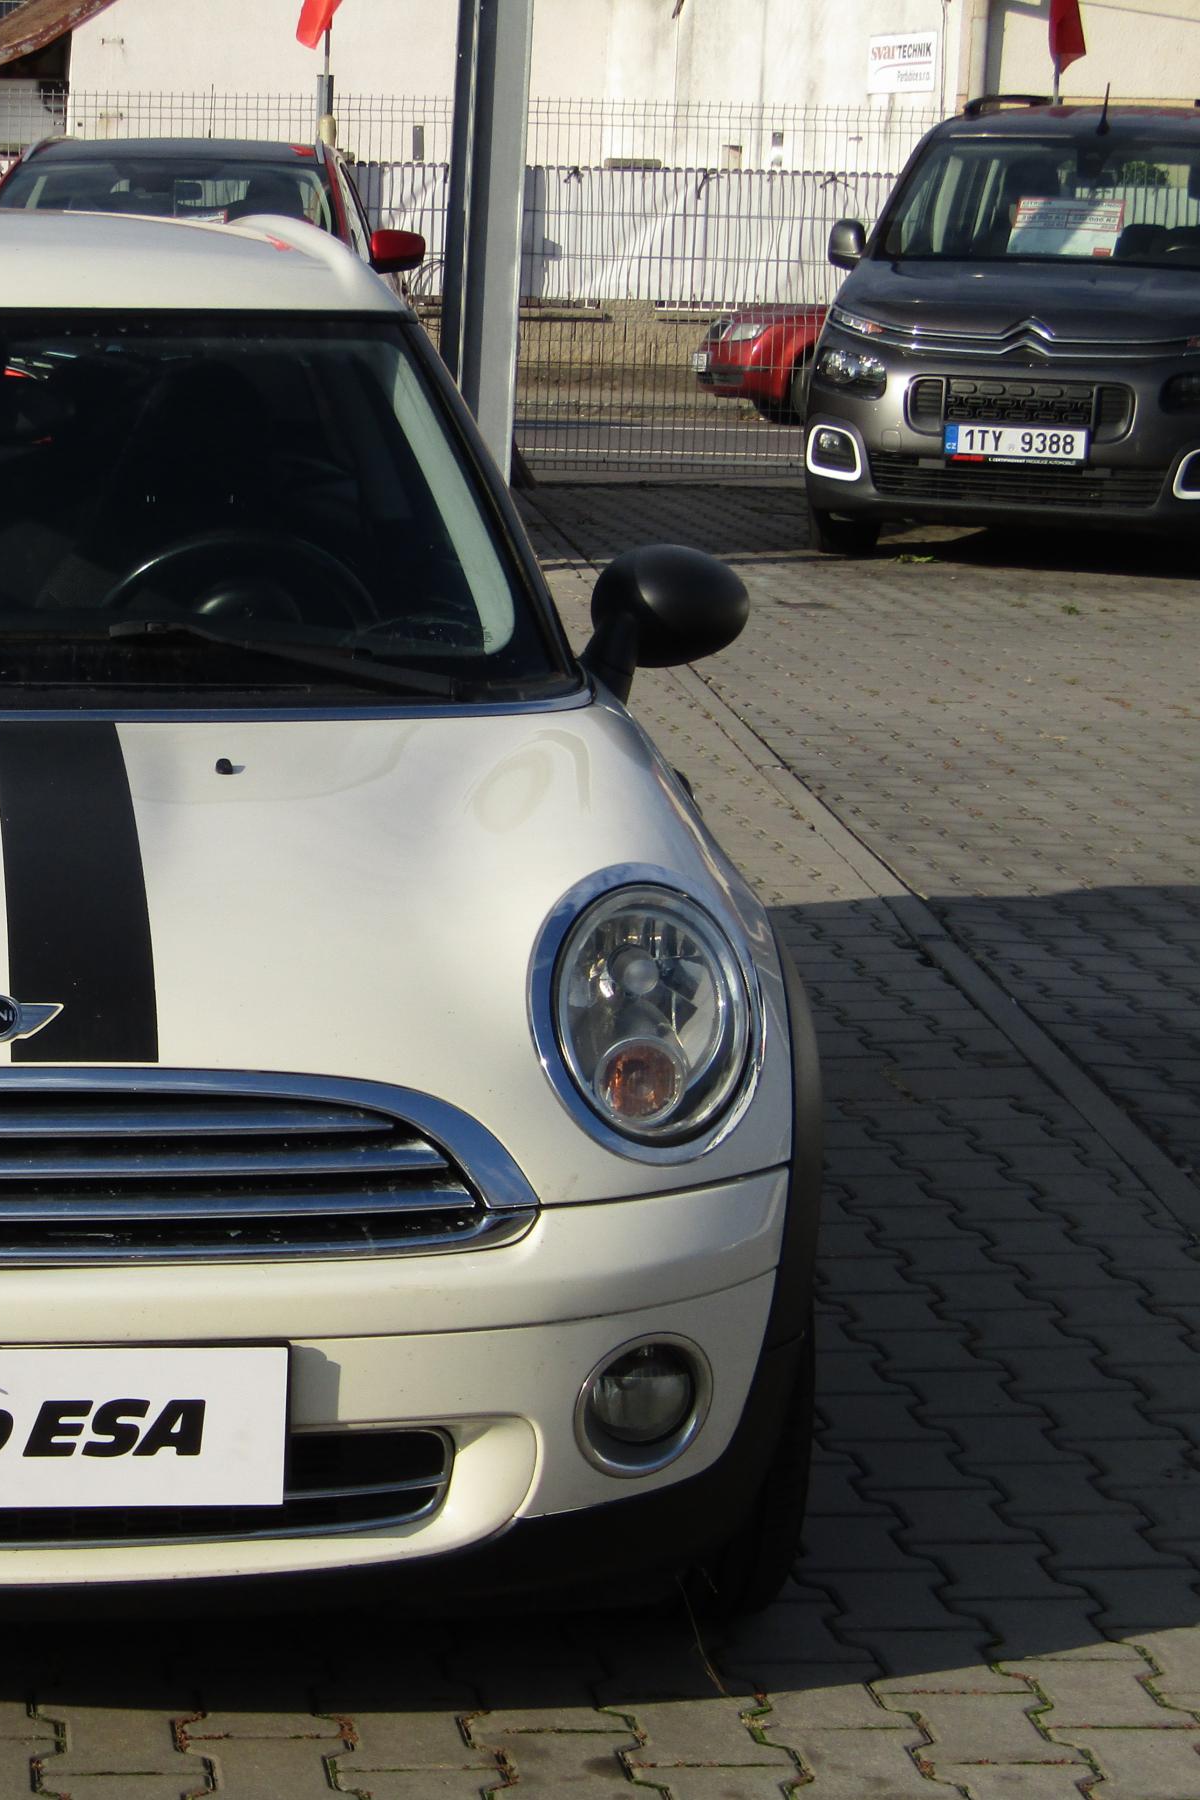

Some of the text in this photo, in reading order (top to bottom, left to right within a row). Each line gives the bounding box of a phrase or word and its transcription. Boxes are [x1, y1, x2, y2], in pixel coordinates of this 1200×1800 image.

[965, 429, 1075, 455] 1TY 9388
[22, 1398, 207, 1458] ESA
